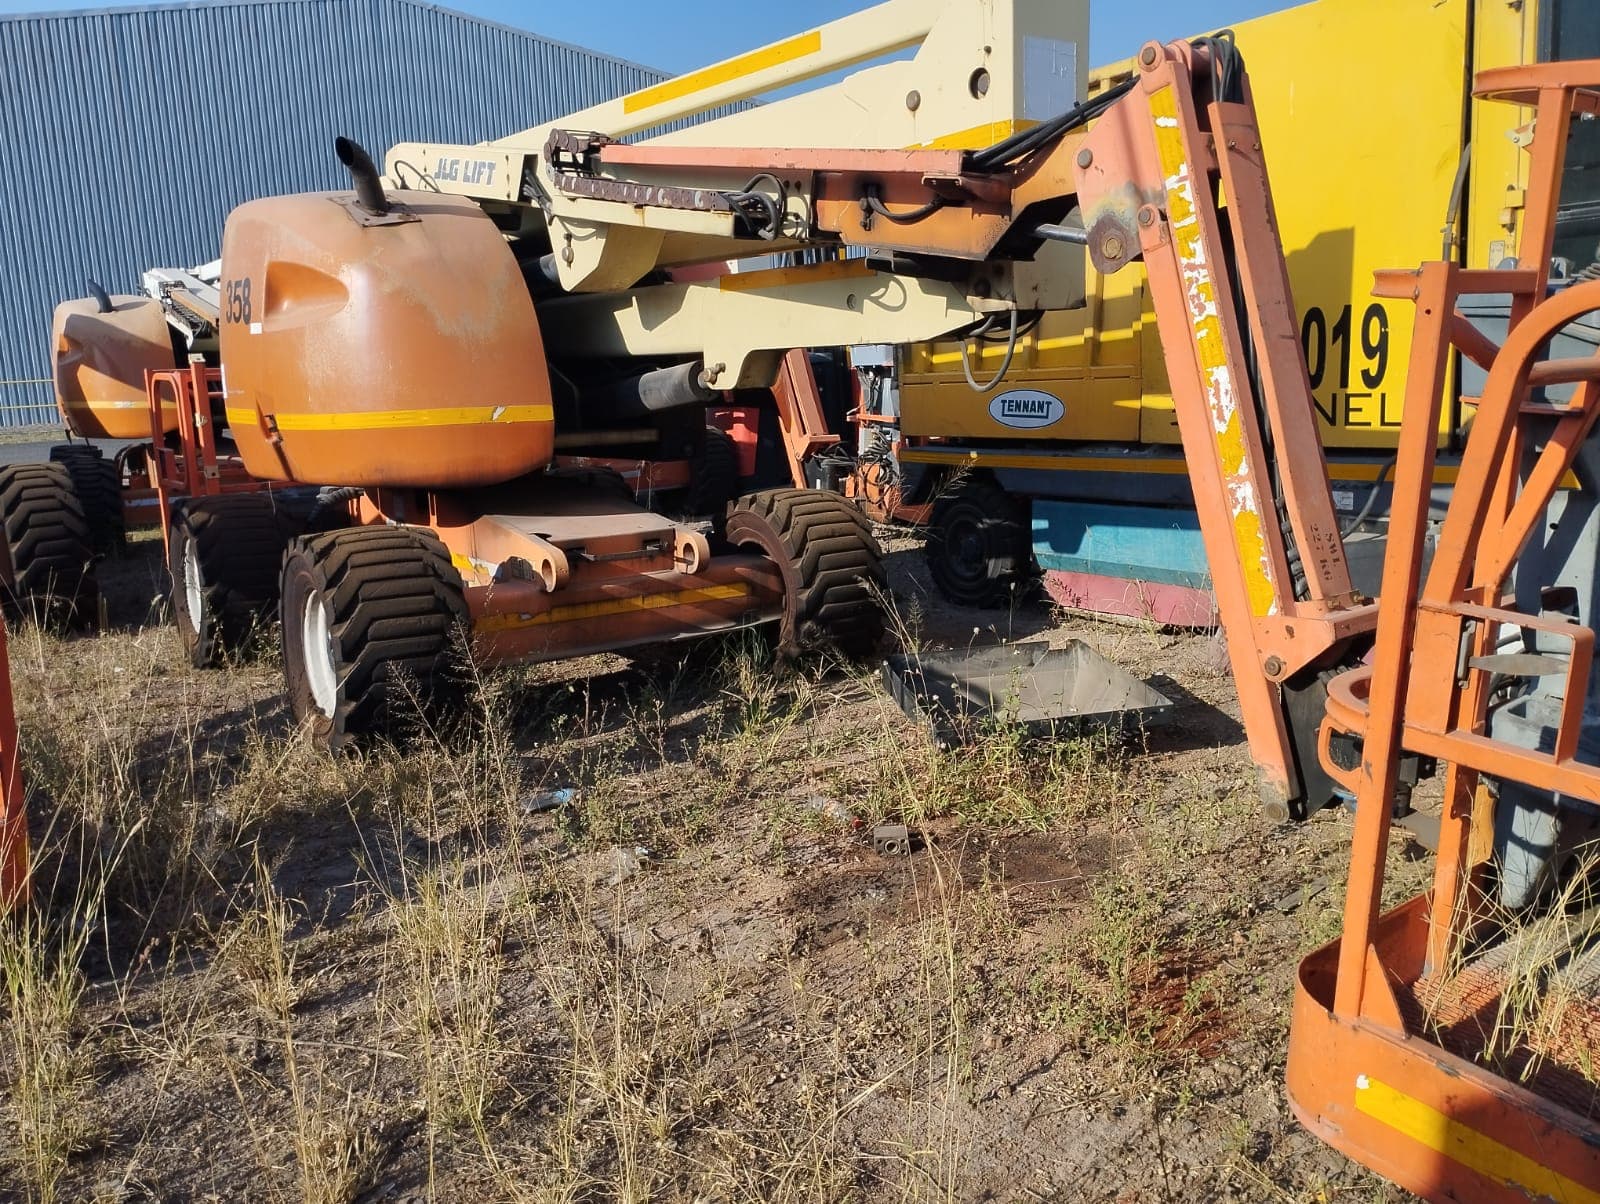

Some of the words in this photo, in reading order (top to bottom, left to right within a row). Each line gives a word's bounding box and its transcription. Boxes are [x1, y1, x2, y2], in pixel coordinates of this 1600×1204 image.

[434, 158, 460, 181] JLG
[463, 160, 497, 185] LIFT
[226, 277, 252, 325] 358
[1001, 399, 1052, 419] TENNANT
